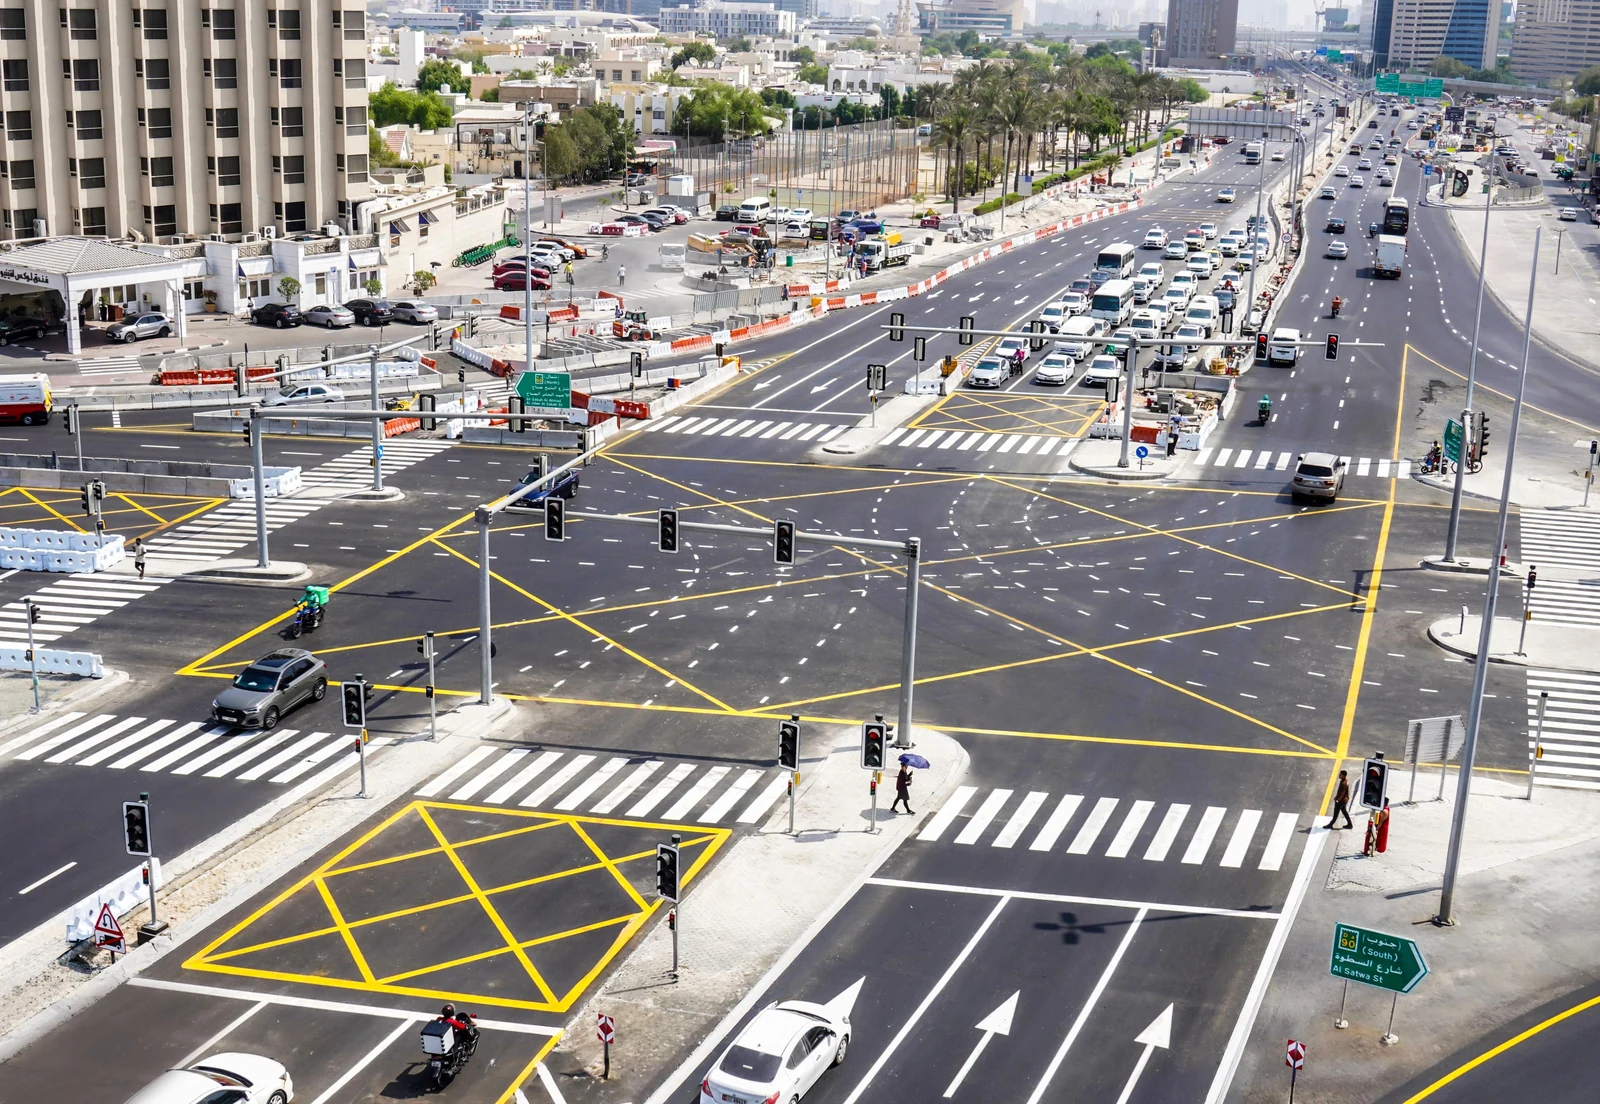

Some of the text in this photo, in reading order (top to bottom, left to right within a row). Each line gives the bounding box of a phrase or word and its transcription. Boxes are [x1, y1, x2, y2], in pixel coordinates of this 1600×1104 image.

[15, 272, 33, 282] لوكس
[33, 273, 49, 283] فندق
[1341, 938, 1356, 948] 90
[1362, 946, 1398, 962] (South)
[1335, 953, 1403, 975] شارع السطوة
[1344, 967, 1370, 980] Satwa
[1373, 975, 1383, 983] St
